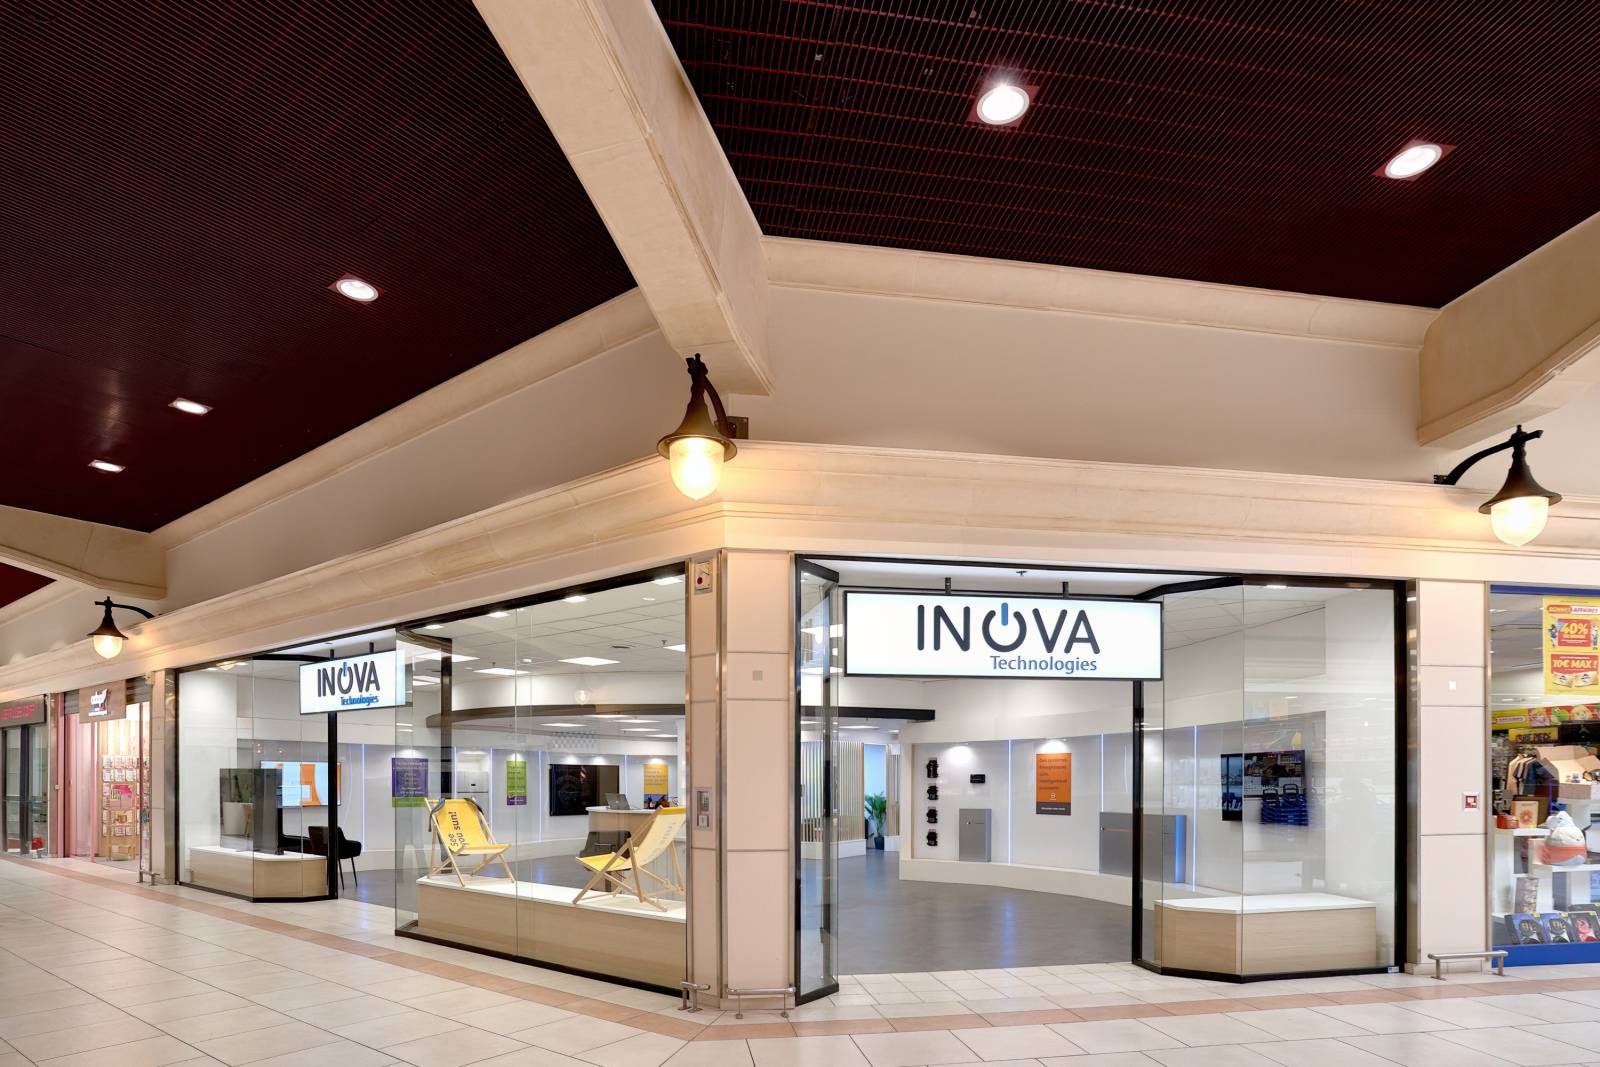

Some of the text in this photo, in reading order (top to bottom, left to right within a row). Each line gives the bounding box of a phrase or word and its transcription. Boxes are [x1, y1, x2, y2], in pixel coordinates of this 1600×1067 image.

[917, 602, 1101, 655] INOVA
[990, 655, 1097, 675] Technologies
[1570, 660, 1592, 668] MAX
[317, 660, 381, 697] INOVA
[341, 695, 380, 706] Technologies
